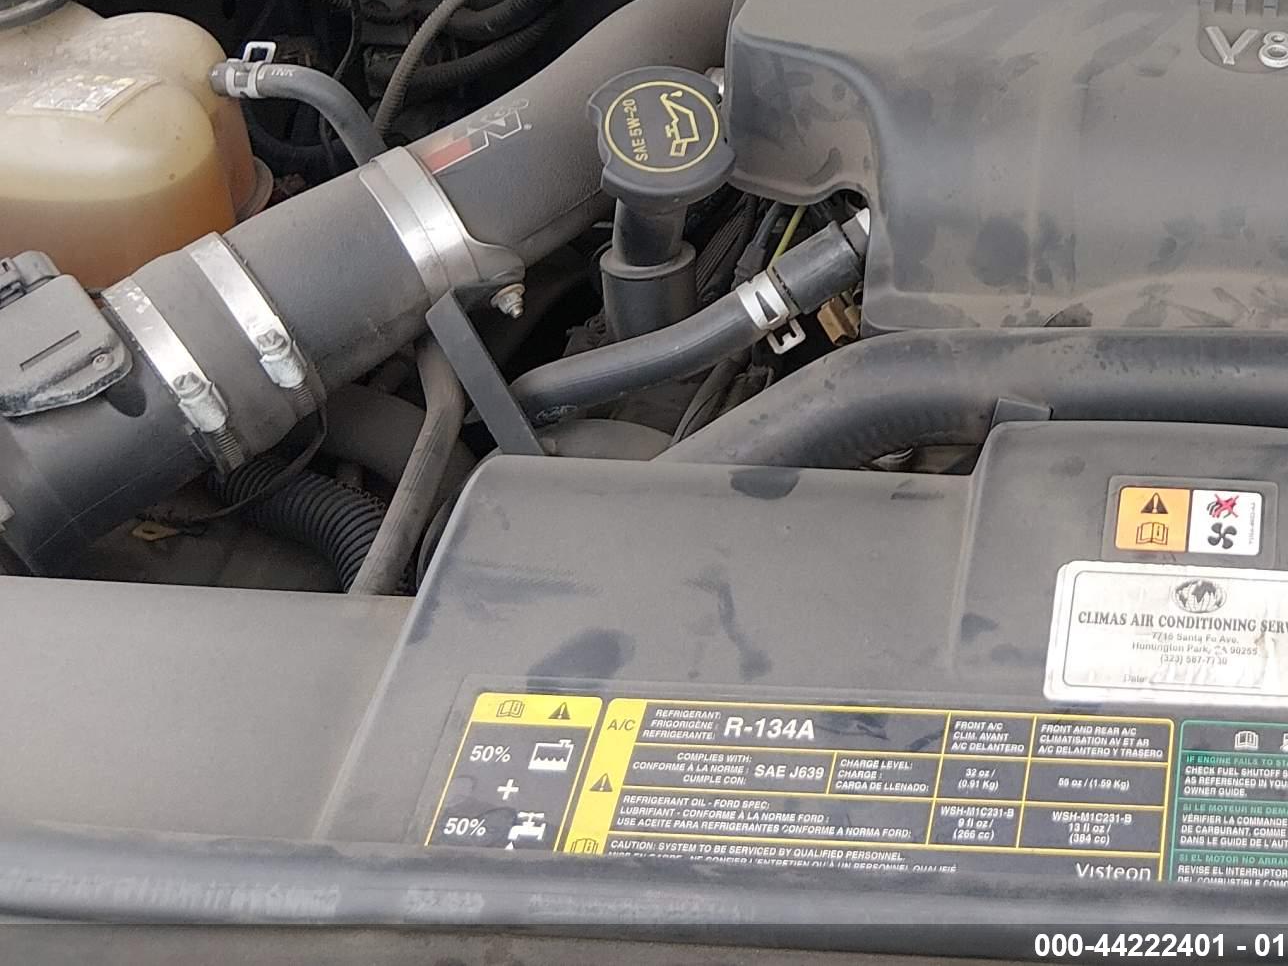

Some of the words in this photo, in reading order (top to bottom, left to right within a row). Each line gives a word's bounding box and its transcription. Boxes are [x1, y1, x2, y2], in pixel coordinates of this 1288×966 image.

[622, 99, 642, 137] 5W-20
[632, 138, 648, 161] SAE
[1078, 611, 1127, 625] CLIMAS
[1130, 613, 1154, 627] AIR
[1158, 615, 1257, 632] CONDITIONING
[1177, 633, 1202, 642] Santa
[1132, 643, 1184, 652] Huntington
[608, 719, 635, 731] A/C
[724, 717, 815, 740] R-134A
[955, 721, 986, 730] FRONT
[988, 722, 1003, 731] A/C
[1041, 724, 1071, 734] FRONT
[1074, 725, 1093, 734] AND
[1095, 726, 1119, 735] REAR
[1121, 727, 1136, 736] A/C
[953, 731, 977, 741] CLIM.
[979, 733, 1009, 742] AVANT
[1039, 735, 1108, 746] CLIMATISATION
[1110, 737, 1121, 746] AV
[1123, 738, 1134, 747] ET
[1137, 738, 1149, 747] AR
[470, 745, 511, 762] 50%
[951, 742, 968, 751] A/C
[969, 743, 1024, 753] DELANTERO
[1038, 746, 1054, 754] A/C
[1055, 746, 1110, 756] DELANTERO
[1112, 748, 1119, 757] Y
[1120, 748, 1163, 759] TRASERO
[677, 753, 724, 762] COMPLIES
[726, 755, 752, 763] WITH:
[1198, 756, 1232, 765] ENGINE
[633, 762, 685, 771] CONFORME
[696, 763, 708, 772] LA
[710, 764, 744, 774] NORME
[840, 759, 878, 768] CHARGE
[881, 761, 912, 770] LEVEL:
[755, 765, 786, 778] SAE
[789, 766, 824, 779] J639
[838, 770, 877, 779] CHARGE
[966, 768, 977, 777] 32
[978, 770, 990, 778] oz
[1185, 766, 1215, 775] CHECK
[1217, 767, 1239, 775] FUEL
[1241, 768, 1280, 777] SHUTOFF
[683, 774, 722, 784] CUMPLE
[723, 776, 746, 785] CON:
[958, 779, 981, 790] (0.91
[983, 780, 999, 792] Kg)
[1071, 779, 1082, 788] oz
[1114, 779, 1130, 791] Kg)
[1185, 777, 1196, 785] AS
[1199, 777, 1256, 787] REFERENCED
[1258, 779, 1267, 787] IN
[836, 781, 868, 790] CARGA
[870, 783, 882, 791] DE
[884, 783, 929, 793] LLENADO:
[1184, 787, 1216, 796] OWNER
[1218, 788, 1247, 797] GUIDE.
[623, 796, 689, 806] REFRIGERANT
[691, 798, 706, 807] OIL
[714, 799, 740, 808] FORD
[620, 807, 675, 816] LUBRIFIANT
[683, 810, 735, 820] CONFORME
[748, 811, 759, 820] LA
[761, 813, 795, 822] NORME
[798, 814, 824, 823] FORD
[940, 806, 1014, 818] WSH-M1C231-B
[1052, 812, 1132, 824] WSH-M1C231-B
[958, 819, 965, 828] 9
[1224, 815, 1235, 824] LA
[1237, 816, 1287, 826] COMMANDE
[444, 818, 486, 836] 50%
[617, 818, 636, 826] USE
[639, 819, 672, 828] ACEITE
[674, 820, 698, 829] PARA
[701, 821, 784, 833] REFRIGERANTES
[782, 825, 835, 835] CONFORME
[846, 828, 879, 837] NORMA
[882, 829, 911, 839] FORD:
[1068, 824, 1081, 833] 13
[1092, 825, 1104, 834] oz
[1181, 825, 1193, 833] DE
[1254, 828, 1286, 837] COMME
[953, 829, 976, 842] (266
[977, 831, 994, 842] cc)
[1094, 835, 1110, 846] cc)
[1180, 836, 1204, 845] DANS
[1207, 837, 1218, 845] LE
[1220, 838, 1247, 846] GUIDE
[1250, 839, 1261, 847] DE
[611, 840, 656, 850] CAUTION:
[659, 842, 696, 852] SYSTEM
[700, 845, 711, 853] TO
[714, 845, 727, 854] BE
[729, 846, 776, 857] SERVICED
[778, 848, 792, 857] BY
[794, 848, 844, 859] QUALIFIED
[846, 850, 905, 861] PERSONNEL.
[1076, 863, 1151, 881] Visteon
[1177, 865, 1210, 874] REVISE
[1213, 866, 1223, 875] EL
[1226, 867, 1287, 878] INTERRUPTOR
